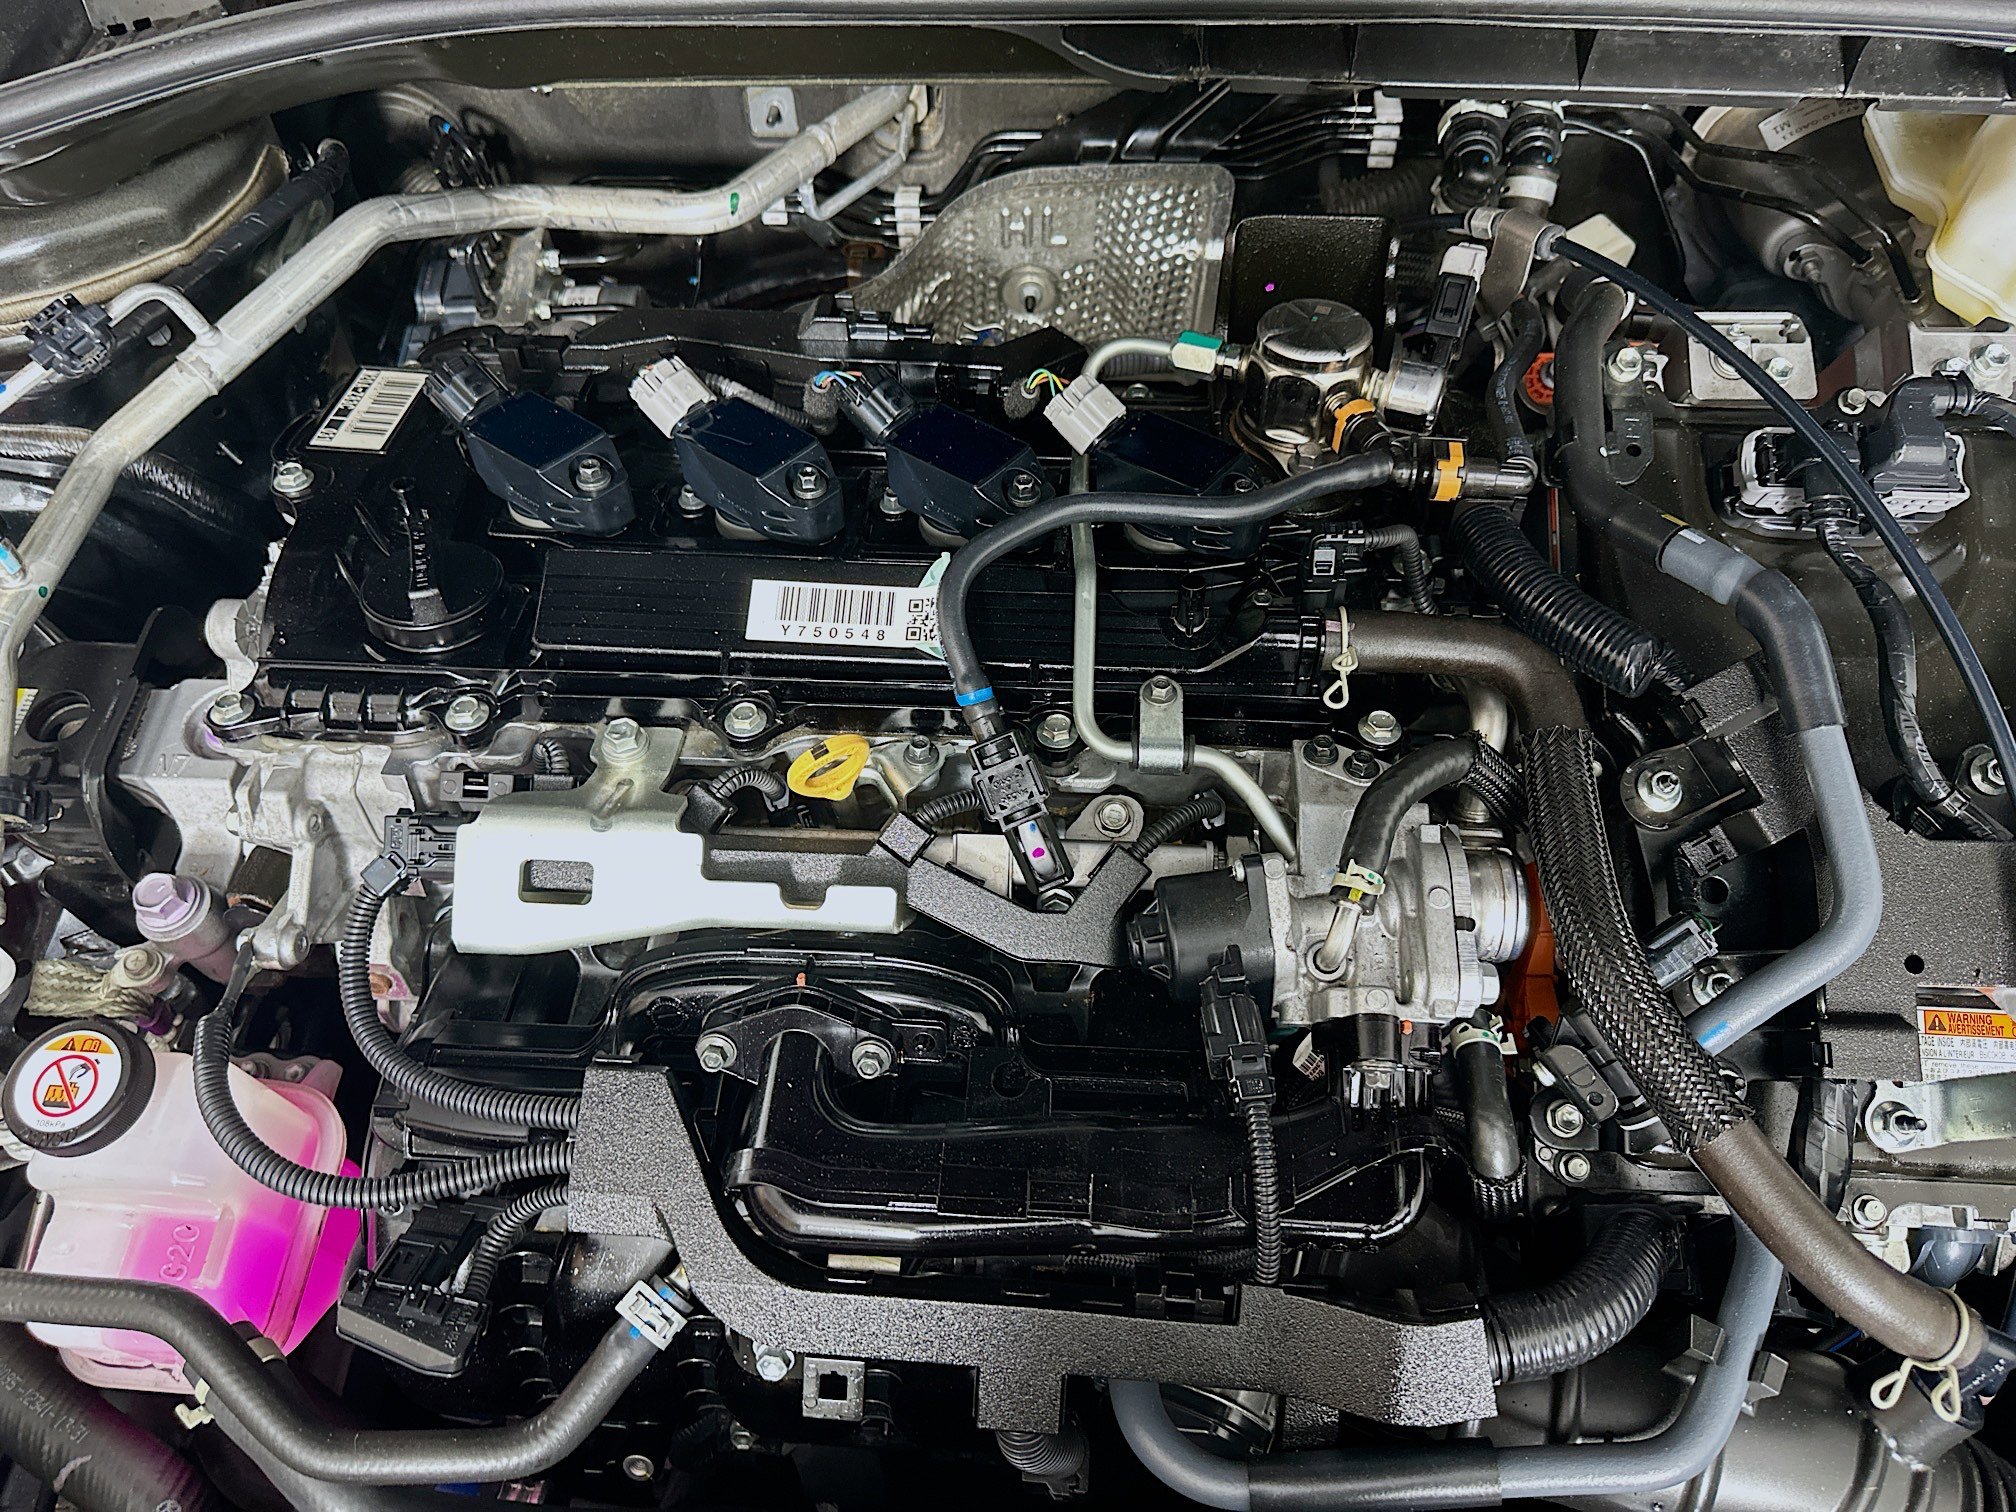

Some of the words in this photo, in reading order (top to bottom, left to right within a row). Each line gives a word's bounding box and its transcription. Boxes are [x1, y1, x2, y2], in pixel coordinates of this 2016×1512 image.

[781, 624, 885, 641] Y750548
[1947, 1012, 1993, 1026] WARNING
[1948, 1023, 2005, 1037] AVERTISSEMENT
[1921, 1036, 1935, 1047] TAGE
